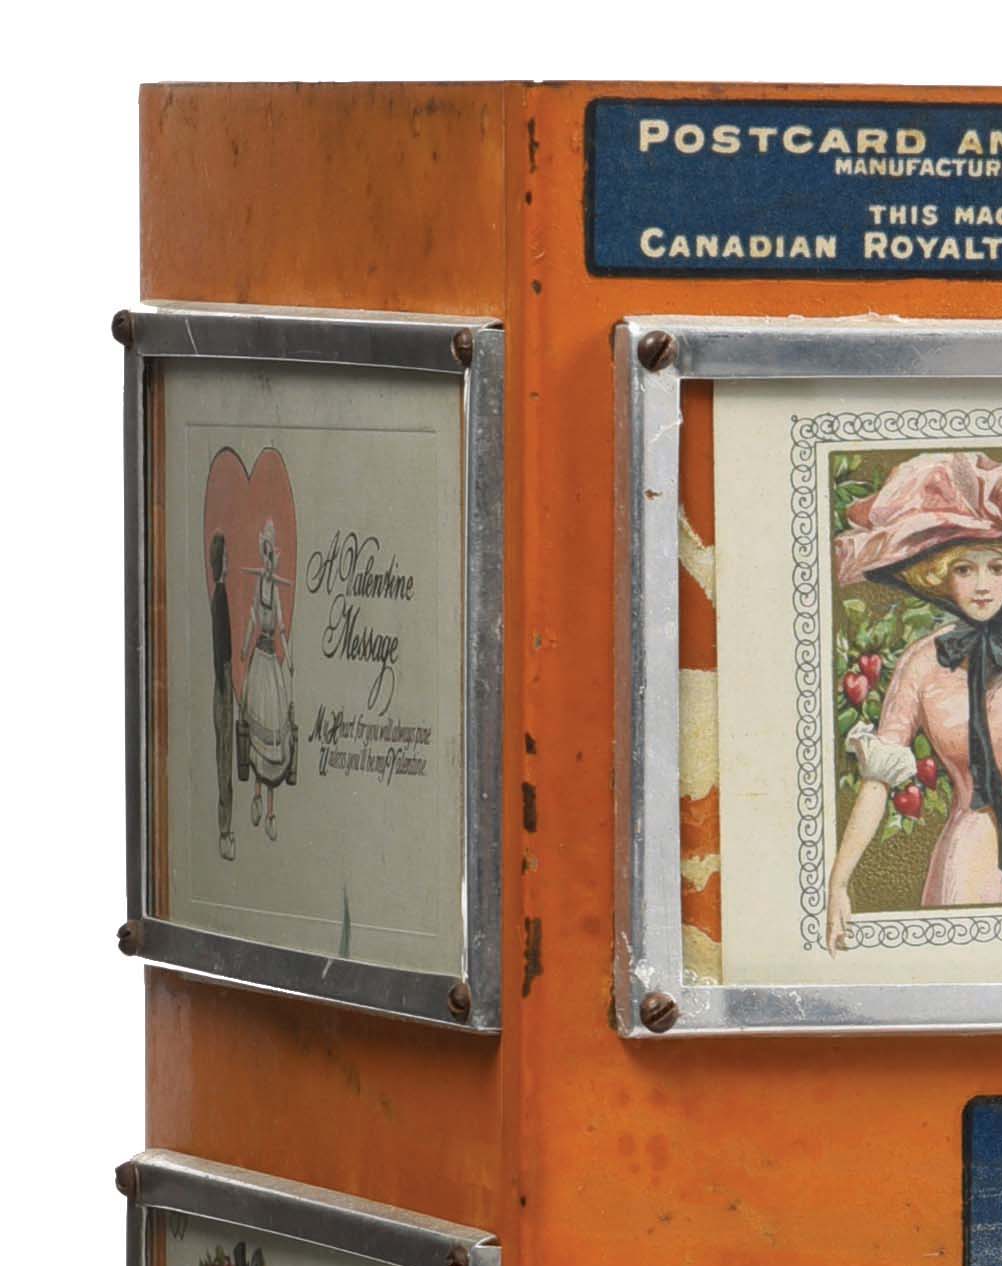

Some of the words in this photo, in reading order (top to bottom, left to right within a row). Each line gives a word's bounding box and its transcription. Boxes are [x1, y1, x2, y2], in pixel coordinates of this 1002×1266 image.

[869, 205, 939, 226] THIS
[339, 531, 415, 601] Valentine
[320, 593, 400, 717] Message
